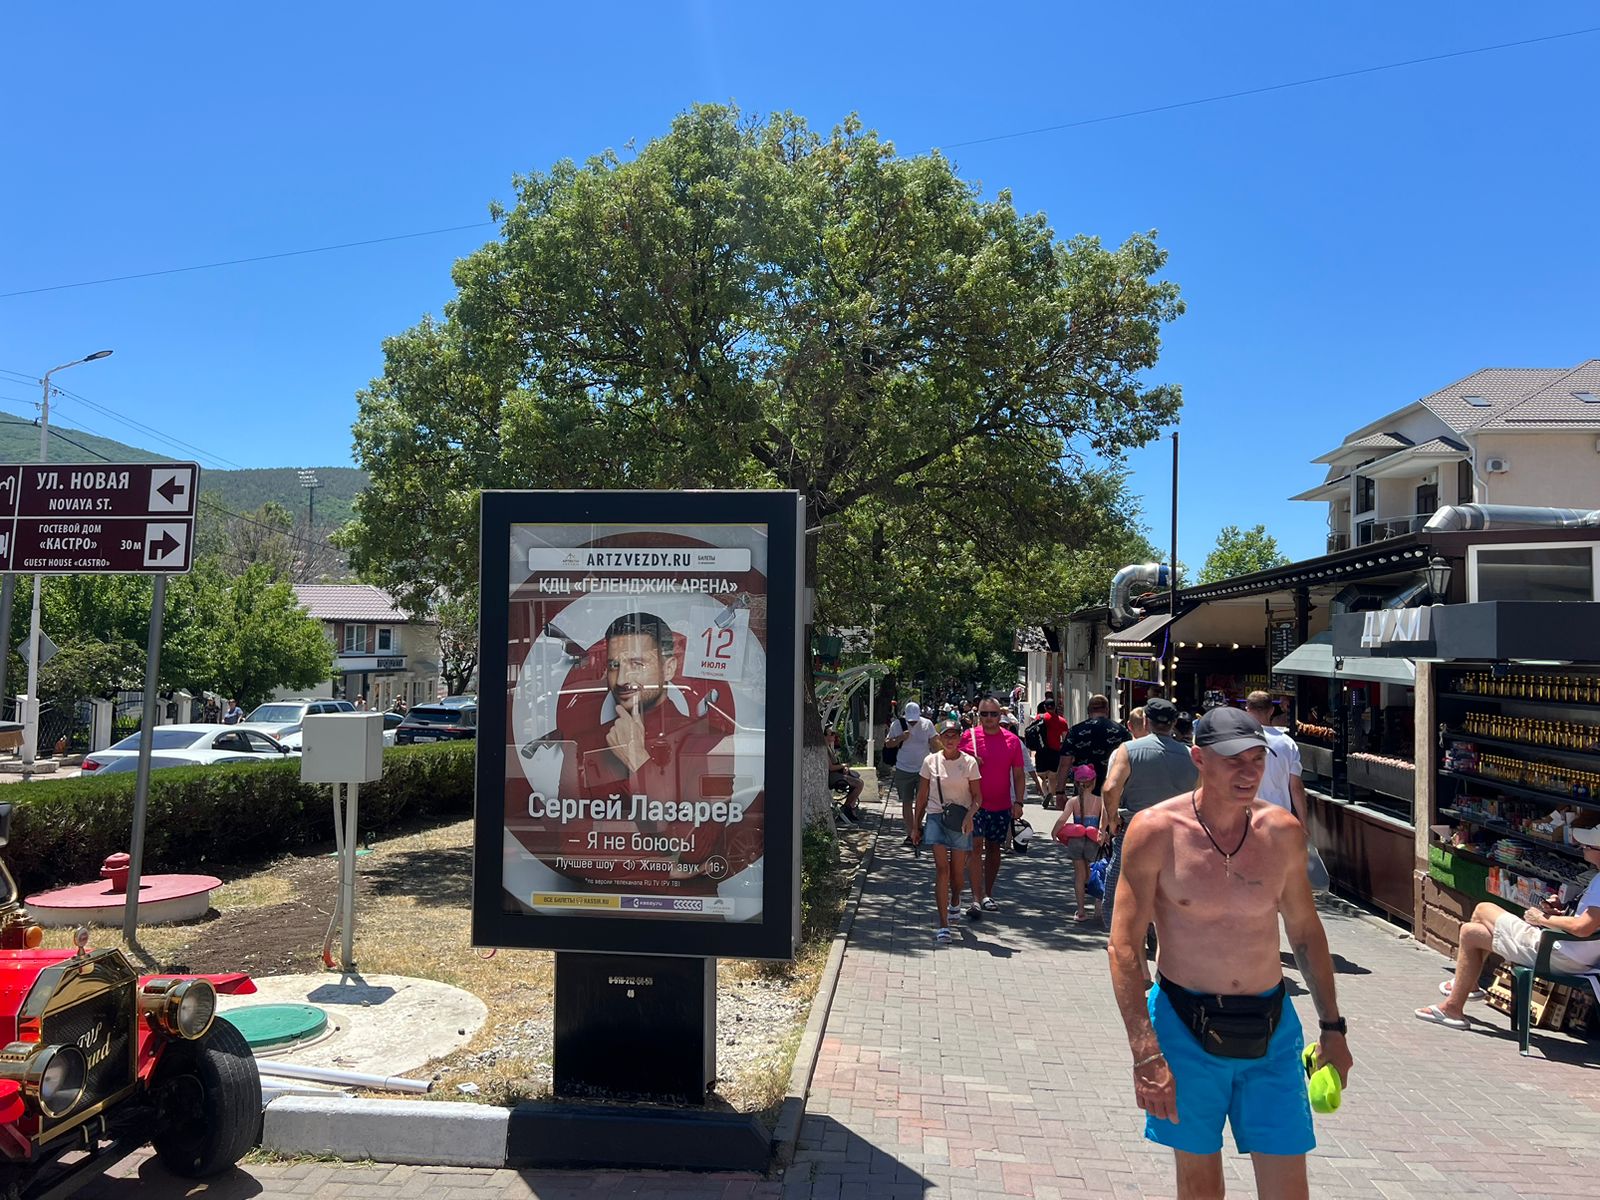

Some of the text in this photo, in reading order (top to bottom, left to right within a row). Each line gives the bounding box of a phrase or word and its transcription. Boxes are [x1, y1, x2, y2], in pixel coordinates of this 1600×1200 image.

[36, 471, 130, 490] УЛ. НОВАЯ
[49, 498, 113, 511] NOVAYA ST.
[38, 523, 102, 535] ГОСТЕВОЙ ДОМ
[39, 537, 98, 550] «КАСТРО»
[23, 558, 111, 567] GUEST HOUSE «CASTRO»
[586, 552, 691, 567] ARTZVEZDY.RU
[539, 577, 738, 595] КДЦ «ГЕЛЕНДЖИК АРЕНА»
[1361, 606, 1428, 648] ДУХИ
[701, 627, 734, 659] 12
[528, 792, 744, 827] Сергей Лазарев
[587, 832, 598, 849] Я
[603, 836, 625, 850] не
[631, 832, 695, 852] боюсь!
[555, 857, 593, 870] Лучшее
[639, 859, 674, 872] Живой
[677, 862, 700, 874] звук
[709, 861, 725, 873] 16+
